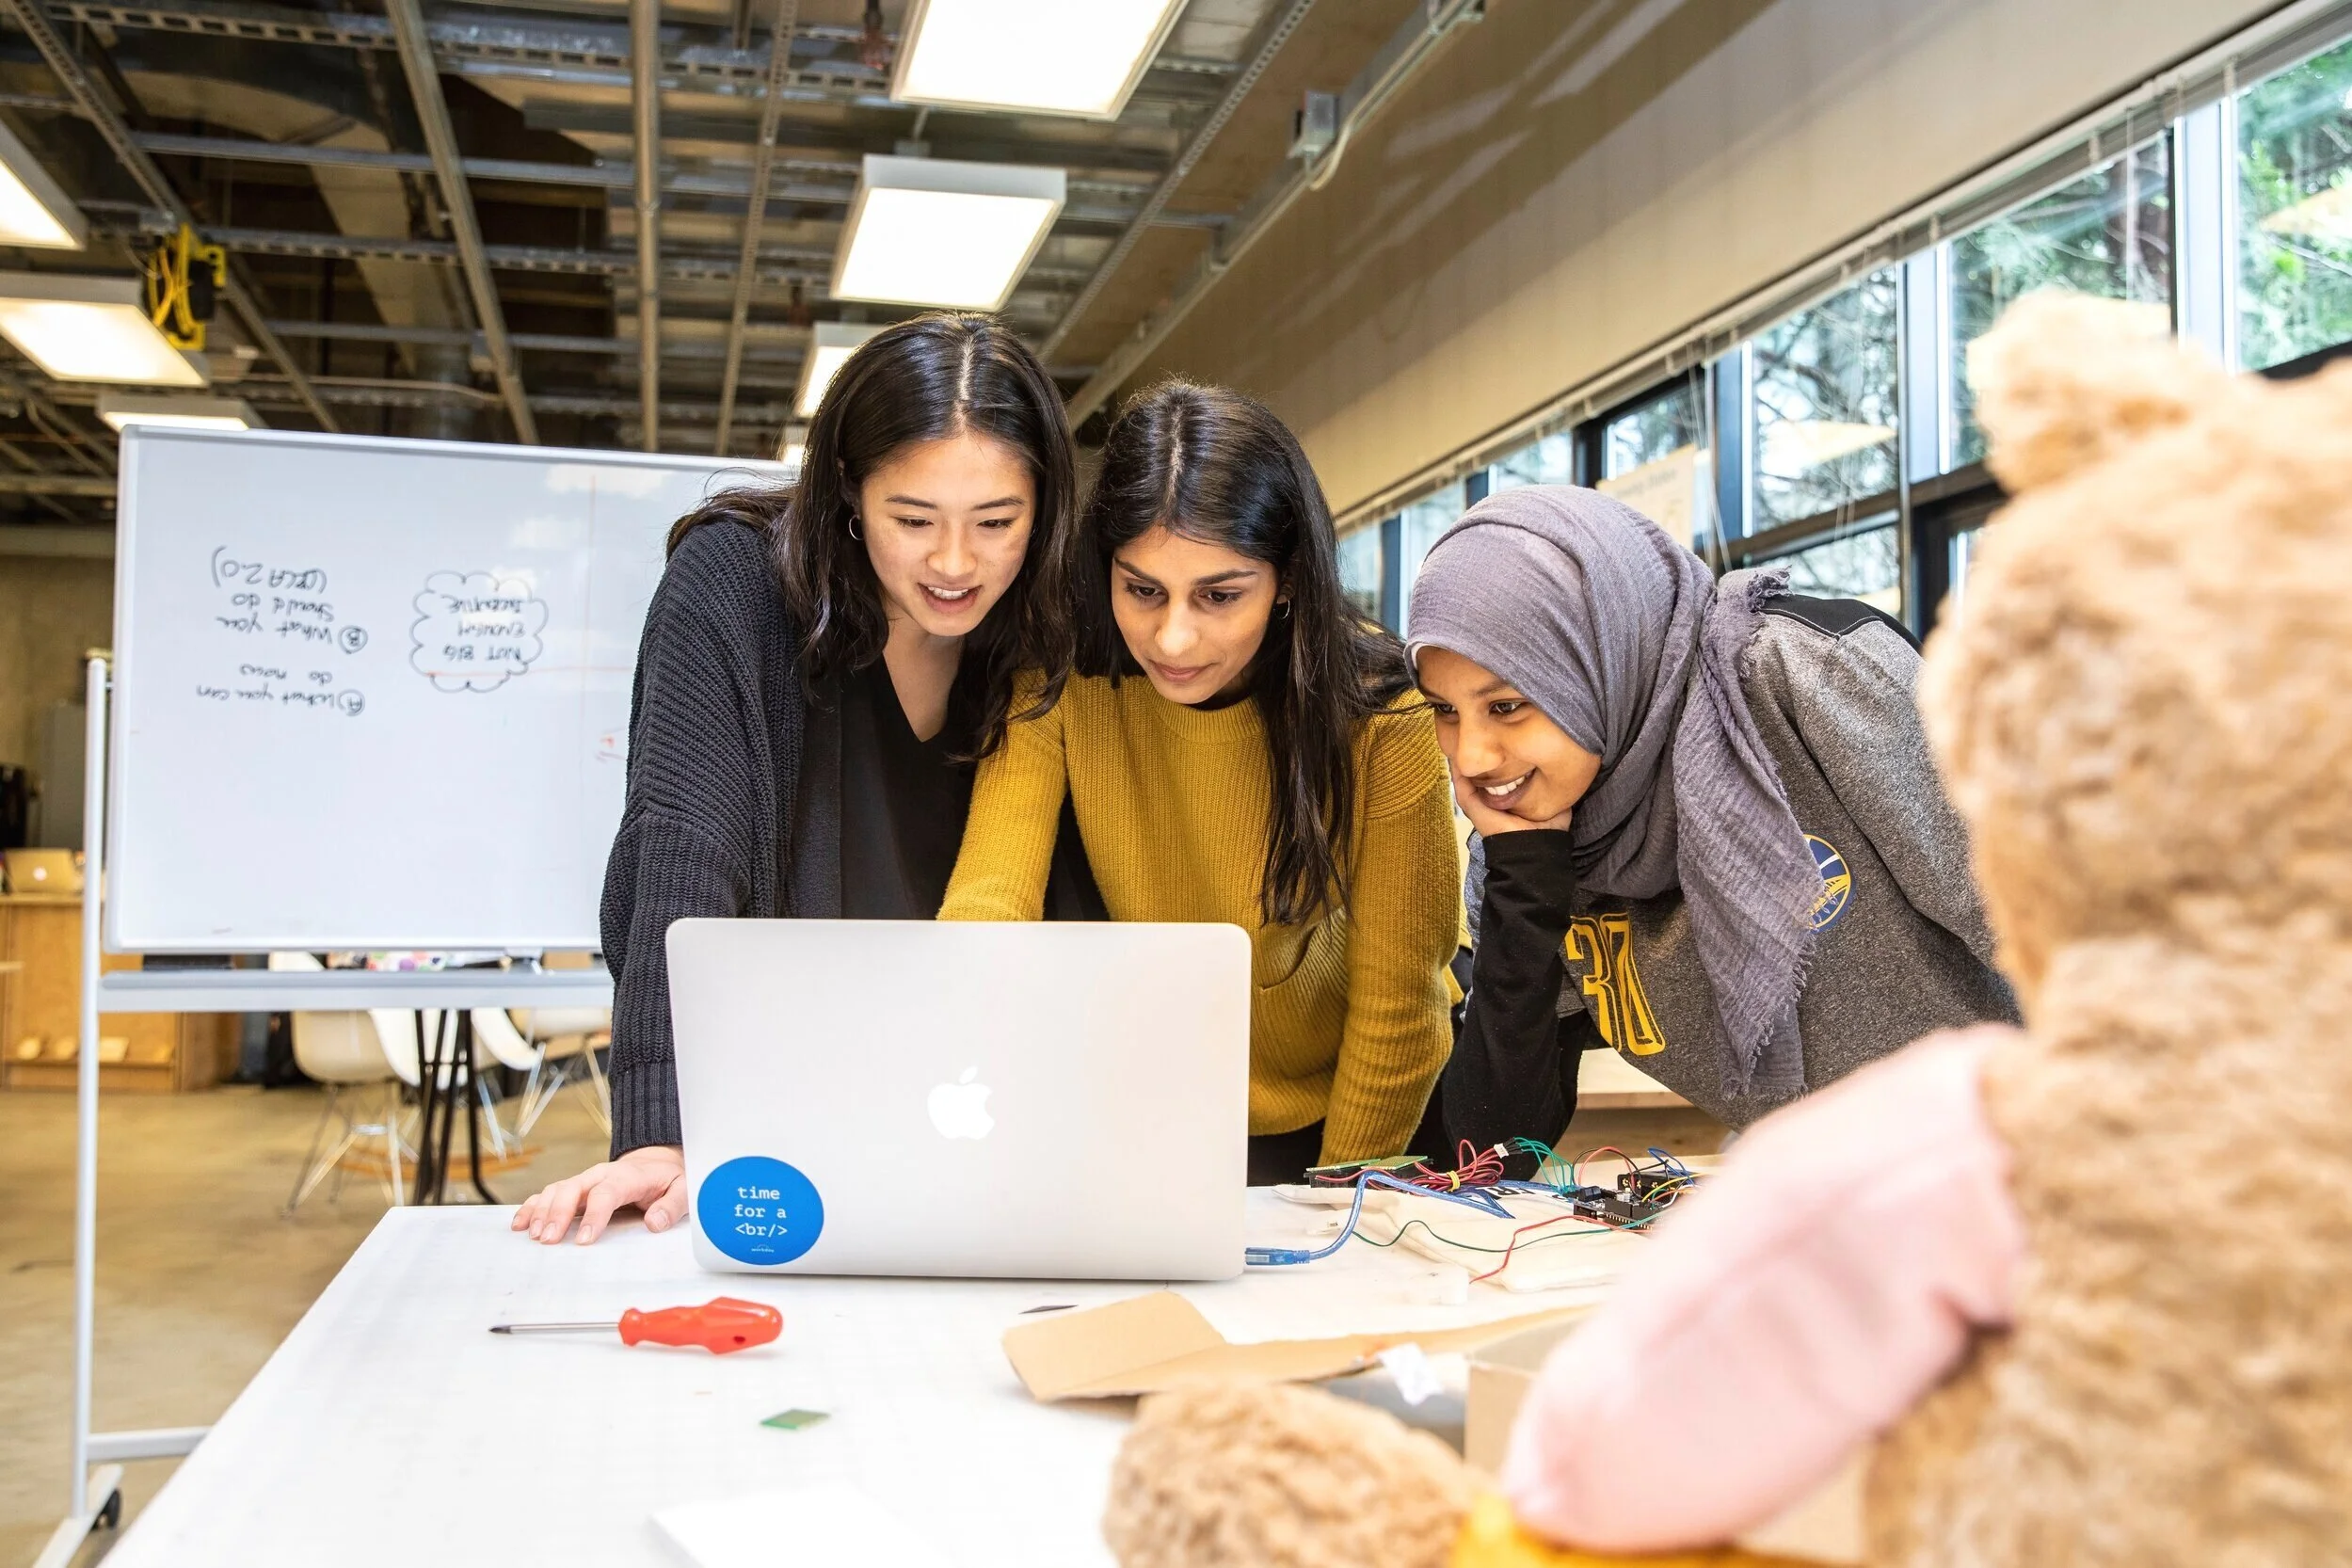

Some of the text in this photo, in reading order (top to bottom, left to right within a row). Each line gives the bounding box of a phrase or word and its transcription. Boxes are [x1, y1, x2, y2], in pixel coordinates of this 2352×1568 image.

[211, 545, 264, 588] 2.0)
[232, 593, 261, 610] do
[215, 612, 264, 633] you
[275, 620, 333, 645] What
[443, 644, 522, 661] NOT BIG
[309, 670, 333, 686] do
[196, 684, 231, 700] can
[235, 682, 274, 700] you
[1564, 912, 1666, 1056] 30
[737, 1185, 780, 1200] time
[734, 1204, 787, 1219] for a
[735, 1223, 788, 1238] <br/>
